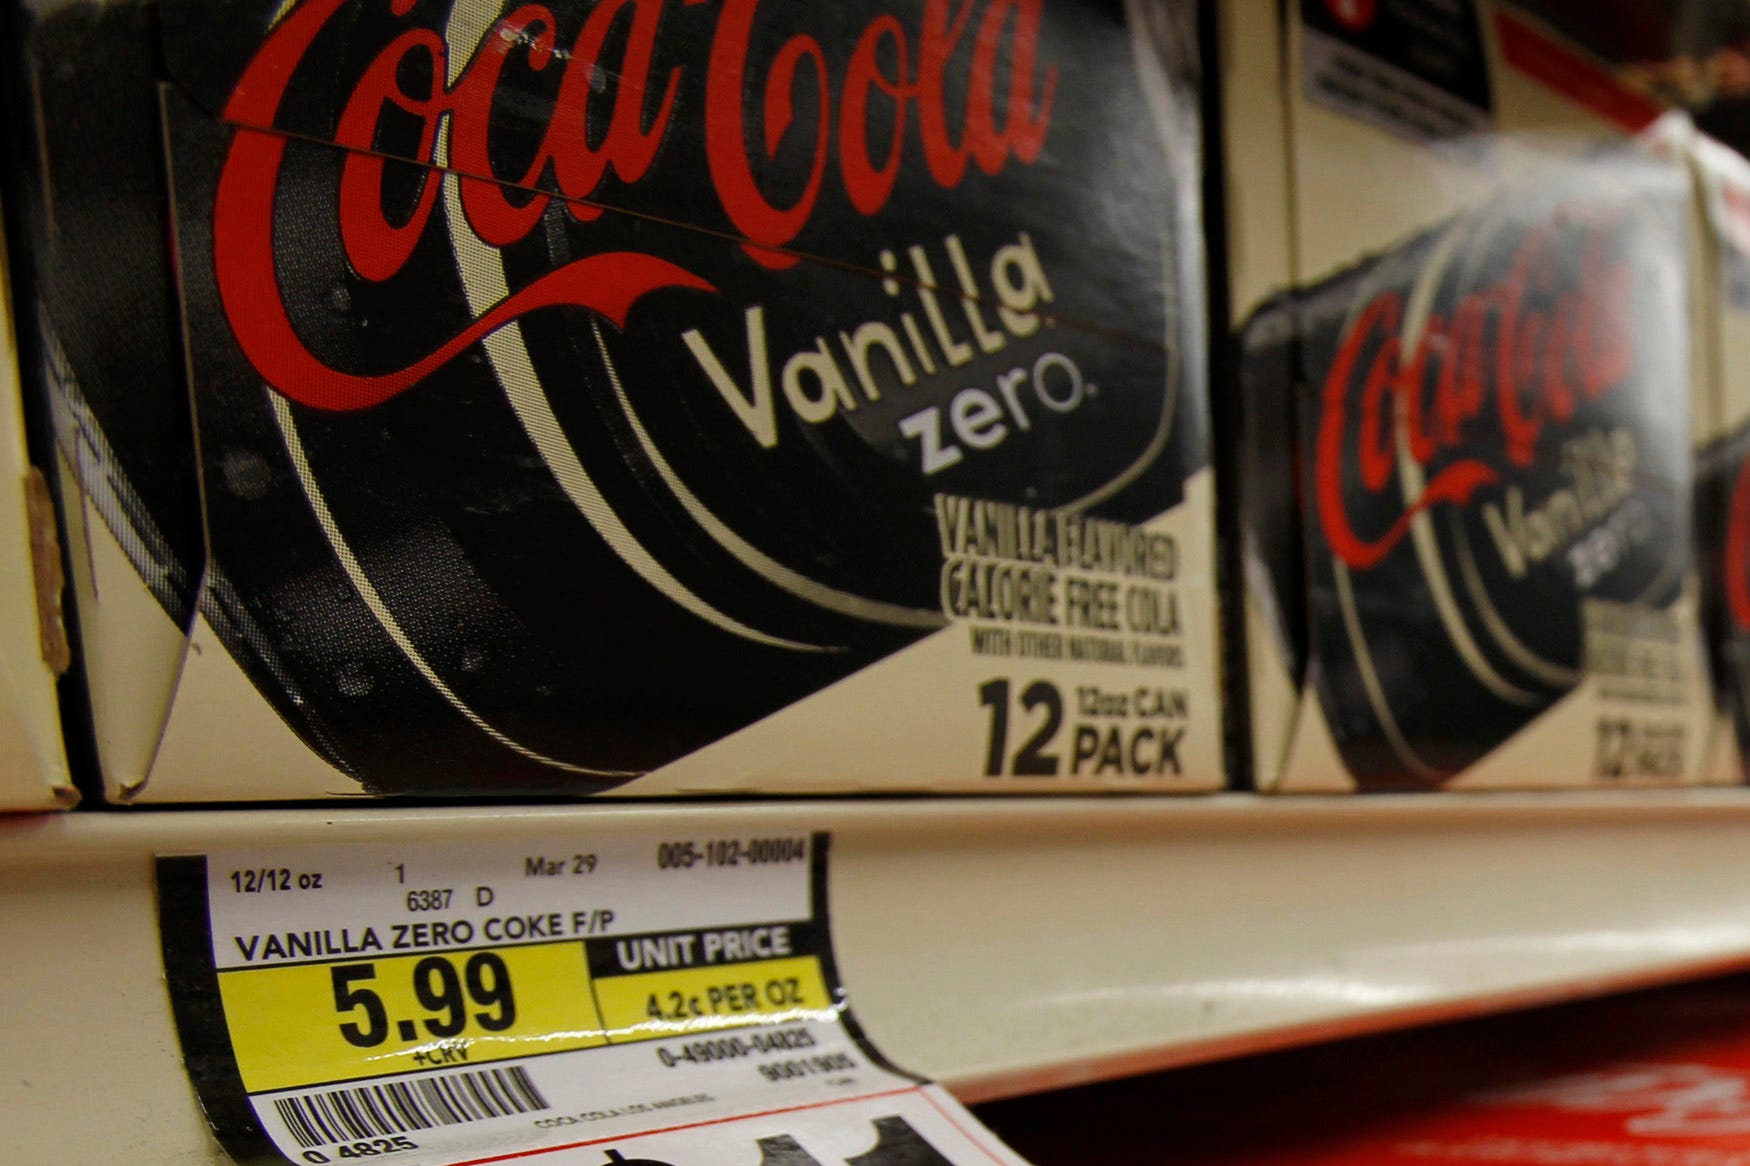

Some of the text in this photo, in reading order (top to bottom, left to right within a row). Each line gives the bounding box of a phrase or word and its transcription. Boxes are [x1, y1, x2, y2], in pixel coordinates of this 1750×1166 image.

[682, 231, 1054, 448] Vanilla
[935, 493, 1056, 566] VANILLA
[940, 560, 1058, 624] CALORIE
[1065, 574, 1120, 630] FREE
[978, 676, 1065, 777] 12
[1134, 684, 1188, 719] CAN
[1071, 723, 1184, 776] PACK
[230, 868, 292, 893] 12/12
[299, 872, 323, 890] oz
[525, 855, 565, 877] Mar
[572, 853, 598, 875] 29
[406, 886, 495, 912] 6387 D
[235, 910, 615, 961] VANILLA ZERO COKE F/P
[617, 926, 792, 971] UNIT PRICE
[330, 951, 517, 1048] 5.99
[706, 983, 760, 1013] PER
[765, 977, 804, 1006] OZ
[338, 1135, 419, 1161] 4825
